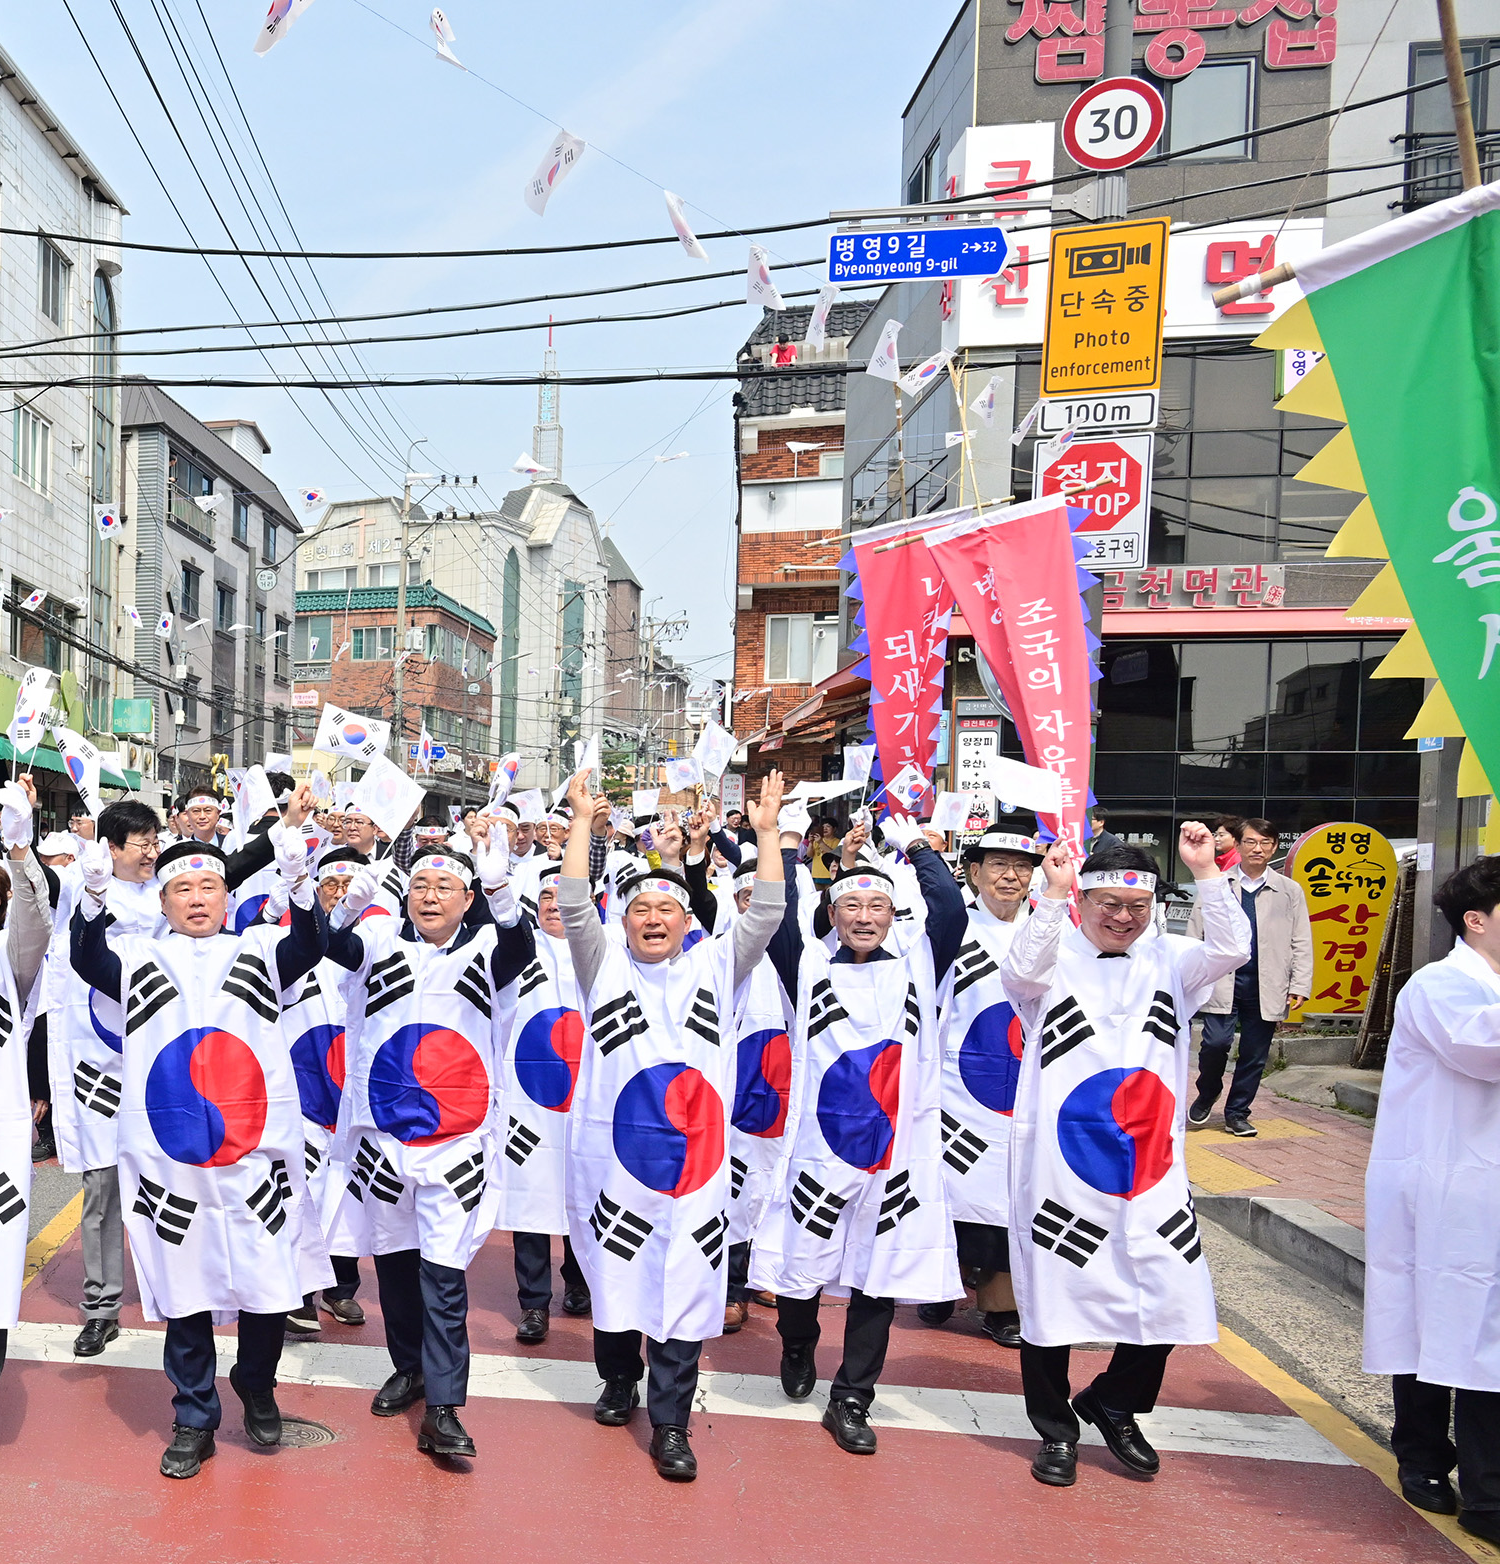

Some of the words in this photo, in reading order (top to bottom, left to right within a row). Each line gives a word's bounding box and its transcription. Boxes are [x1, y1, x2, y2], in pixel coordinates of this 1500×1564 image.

[1088, 104, 1138, 143] 30
[835, 260, 922, 277] Byeongyeong
[926, 258, 958, 272] 9-gil
[1061, 285, 1149, 318] 단속중
[1074, 329, 1130, 348] Photo
[1050, 356, 1151, 378] enforcement
[1065, 402, 1131, 423] 100m
[1055, 458, 1127, 491] 정지
[1103, 564, 1269, 609] 금천면관
[1016, 597, 1062, 695] 조국의
[962, 737, 993, 747] 양장피
[962, 759, 986, 769] 유산
[998, 835, 1019, 848] 대한
[1326, 832, 1372, 855] 병영
[168, 860, 188, 874] 대한
[836, 880, 854, 892] 대한
[1095, 872, 1120, 885] 대한
[1304, 857, 1387, 900] 솥뚜껑
[1308, 903, 1380, 1014] 삼겹살
